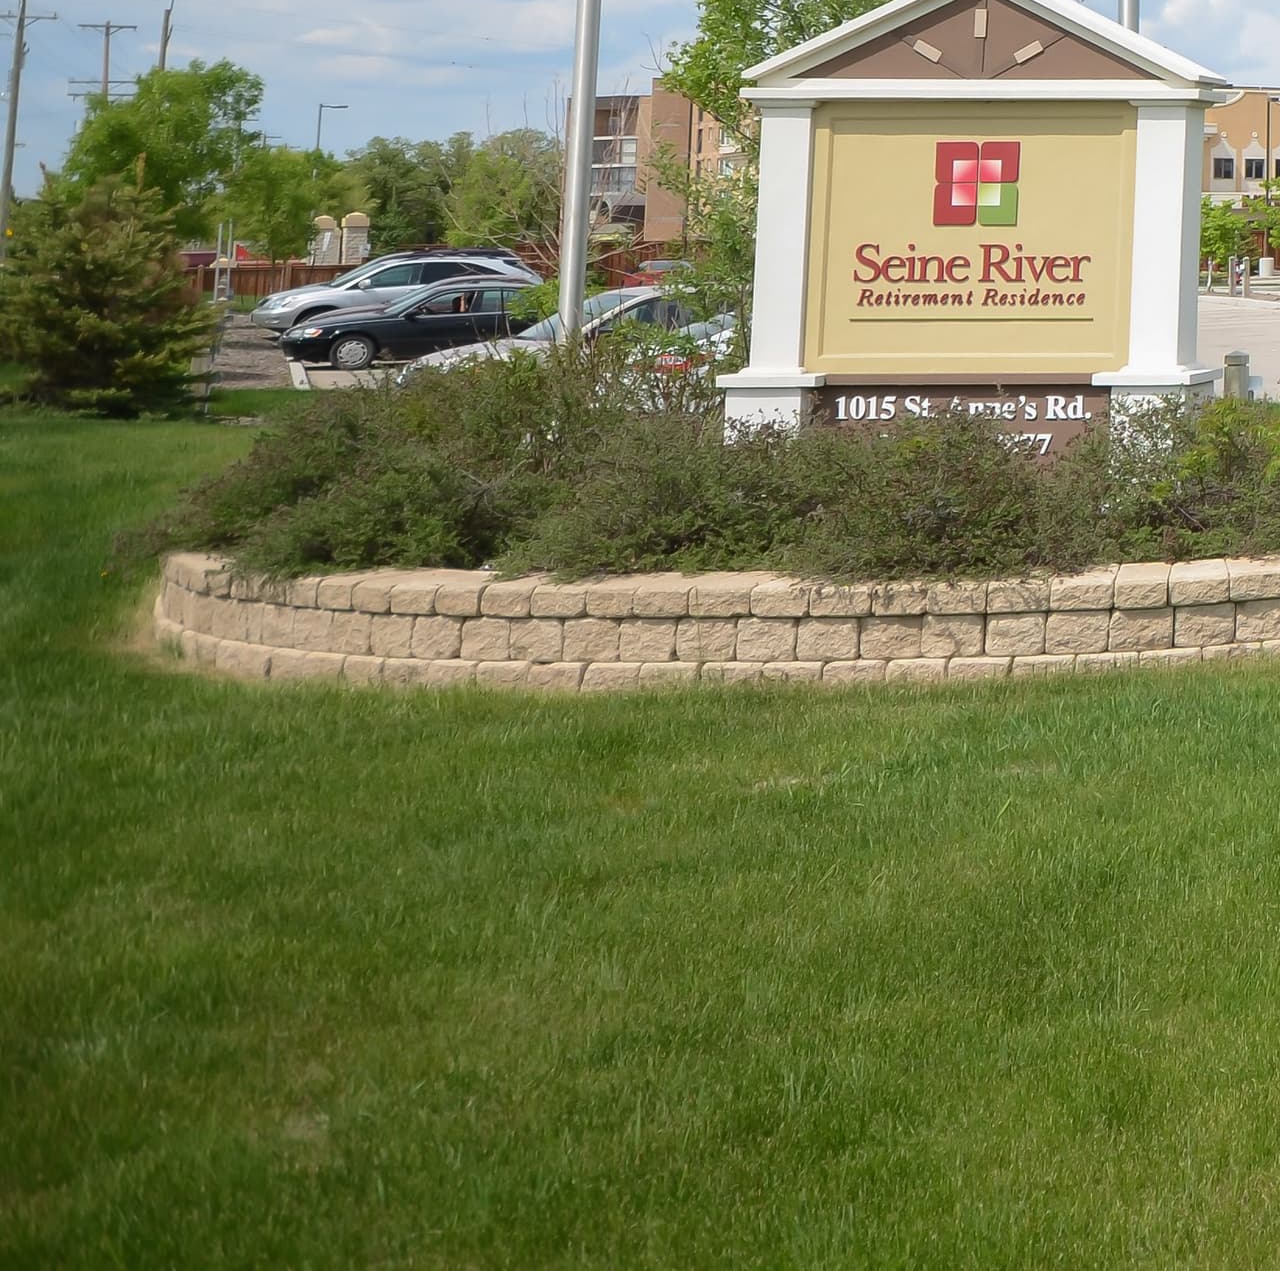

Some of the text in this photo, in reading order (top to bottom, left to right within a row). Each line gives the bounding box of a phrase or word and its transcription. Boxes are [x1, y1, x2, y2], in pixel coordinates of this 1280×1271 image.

[853, 243, 1092, 284] Seine River
[856, 288, 1086, 307] Retirement Residence
[834, 395, 897, 420] 1015
[1045, 395, 1092, 421] Rd.
